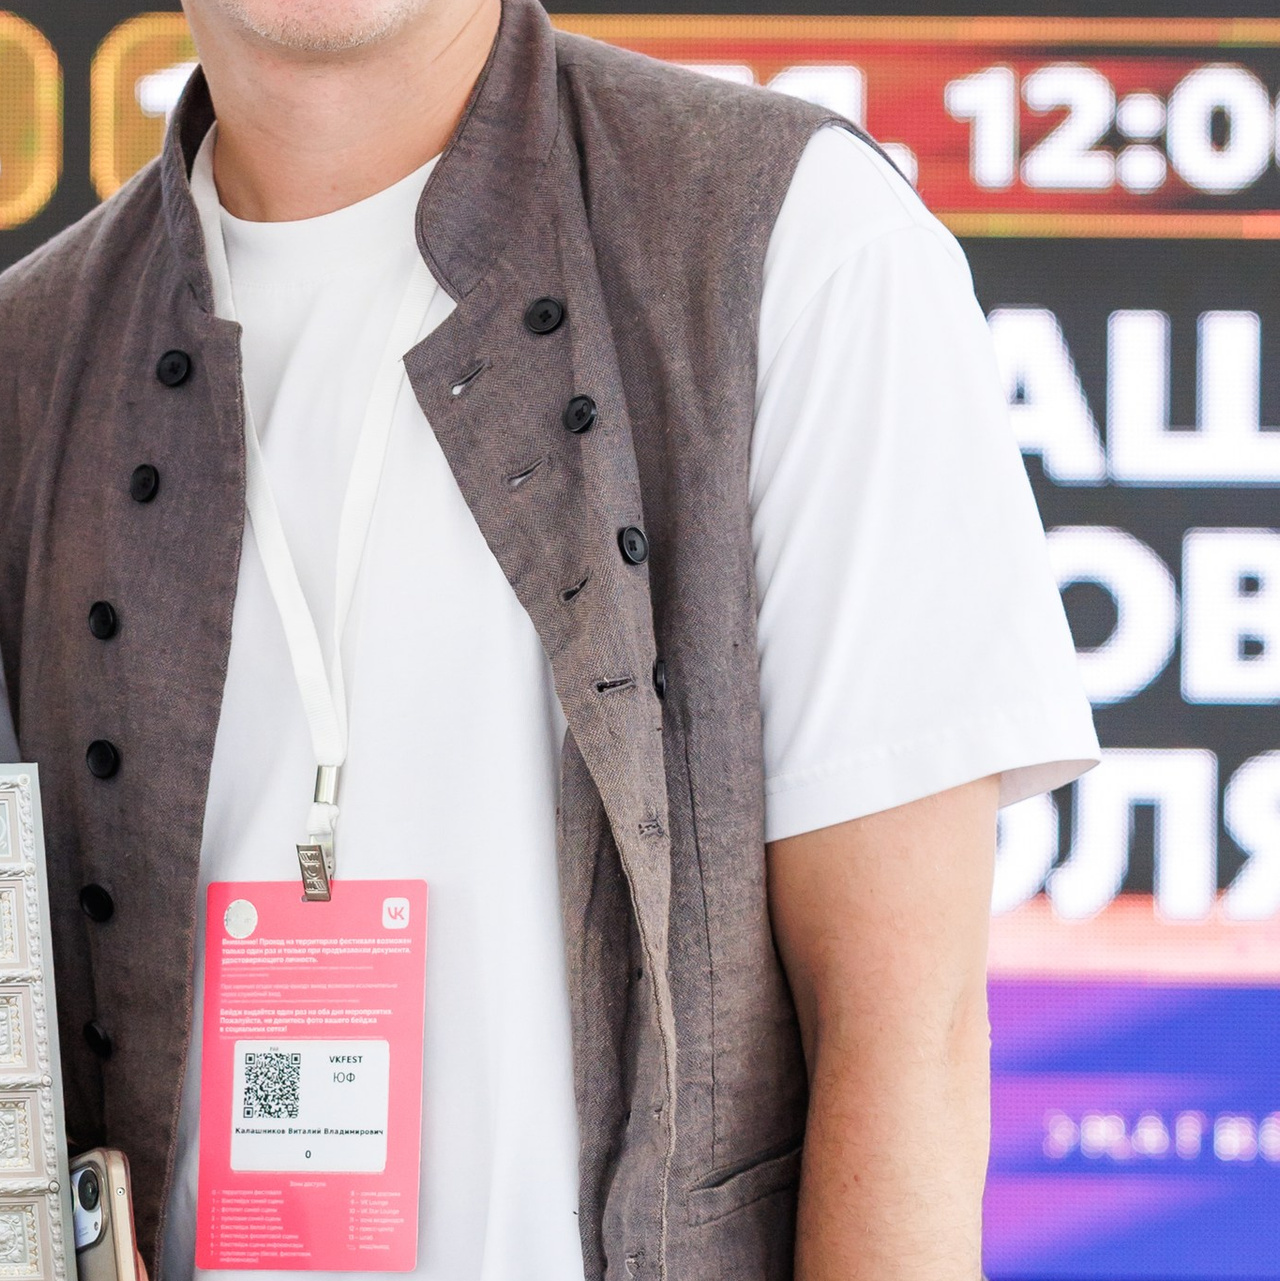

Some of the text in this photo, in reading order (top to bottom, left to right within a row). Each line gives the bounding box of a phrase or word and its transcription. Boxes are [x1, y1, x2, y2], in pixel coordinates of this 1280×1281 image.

[943, 61, 1280, 195] 12:0
[387, 906, 405, 920] VK
[329, 1056, 363, 1064] VKFEST
[333, 1072, 356, 1083] ЮФ
[235, 1127, 384, 1136] Калашников Виталий Владимирович
[305, 1150, 312, 1159] 0
